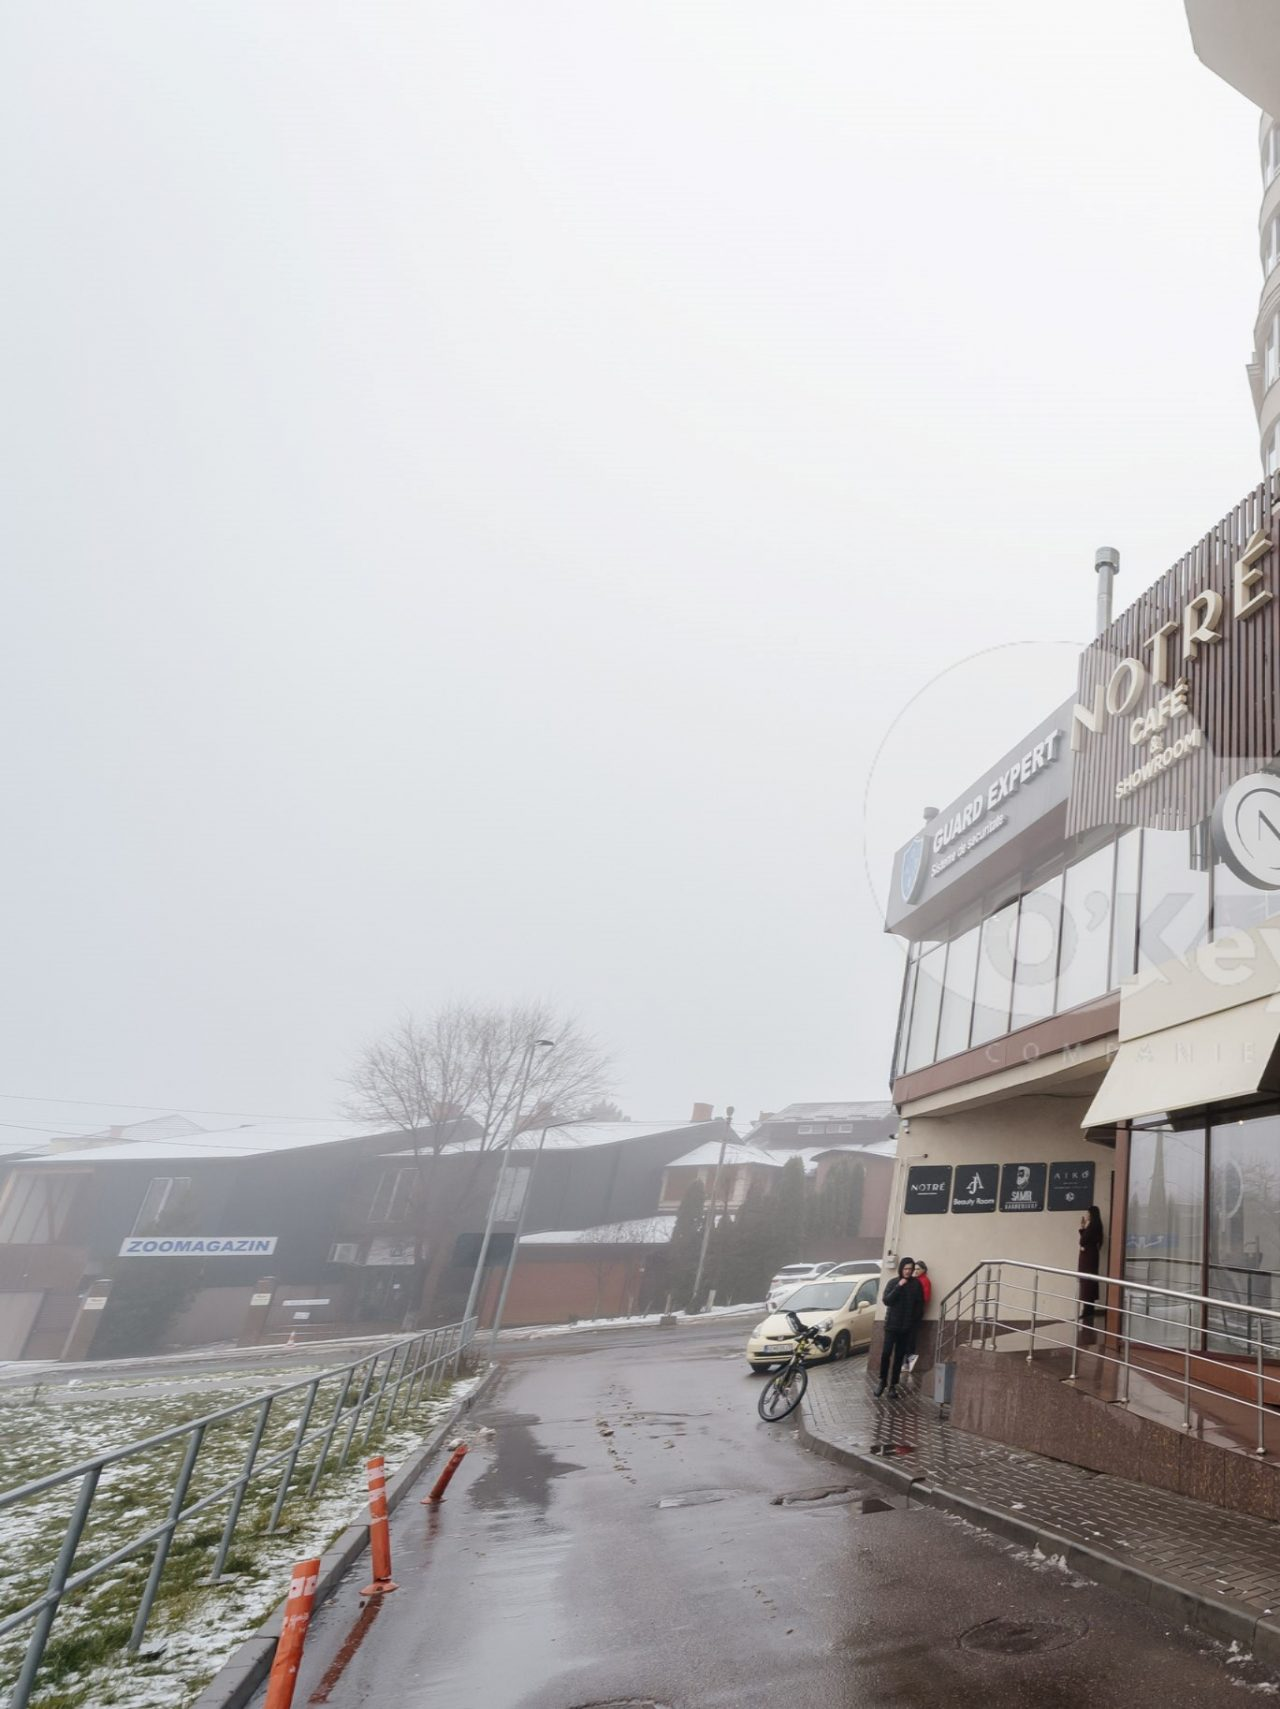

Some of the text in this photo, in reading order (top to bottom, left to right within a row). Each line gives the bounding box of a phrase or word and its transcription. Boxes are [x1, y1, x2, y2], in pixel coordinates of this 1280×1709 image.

[1071, 529, 1273, 752] NOTRÉ
[1130, 677, 1189, 745] CAFÉ
[933, 729, 1062, 853] GUARD EXPERT
[1116, 728, 1201, 800] SHOWROOM
[910, 1182, 946, 1191] NOTRÉ
[953, 1197, 995, 1206] Beauty Room
[126, 1240, 271, 1253] ZOOMAGAZIN
